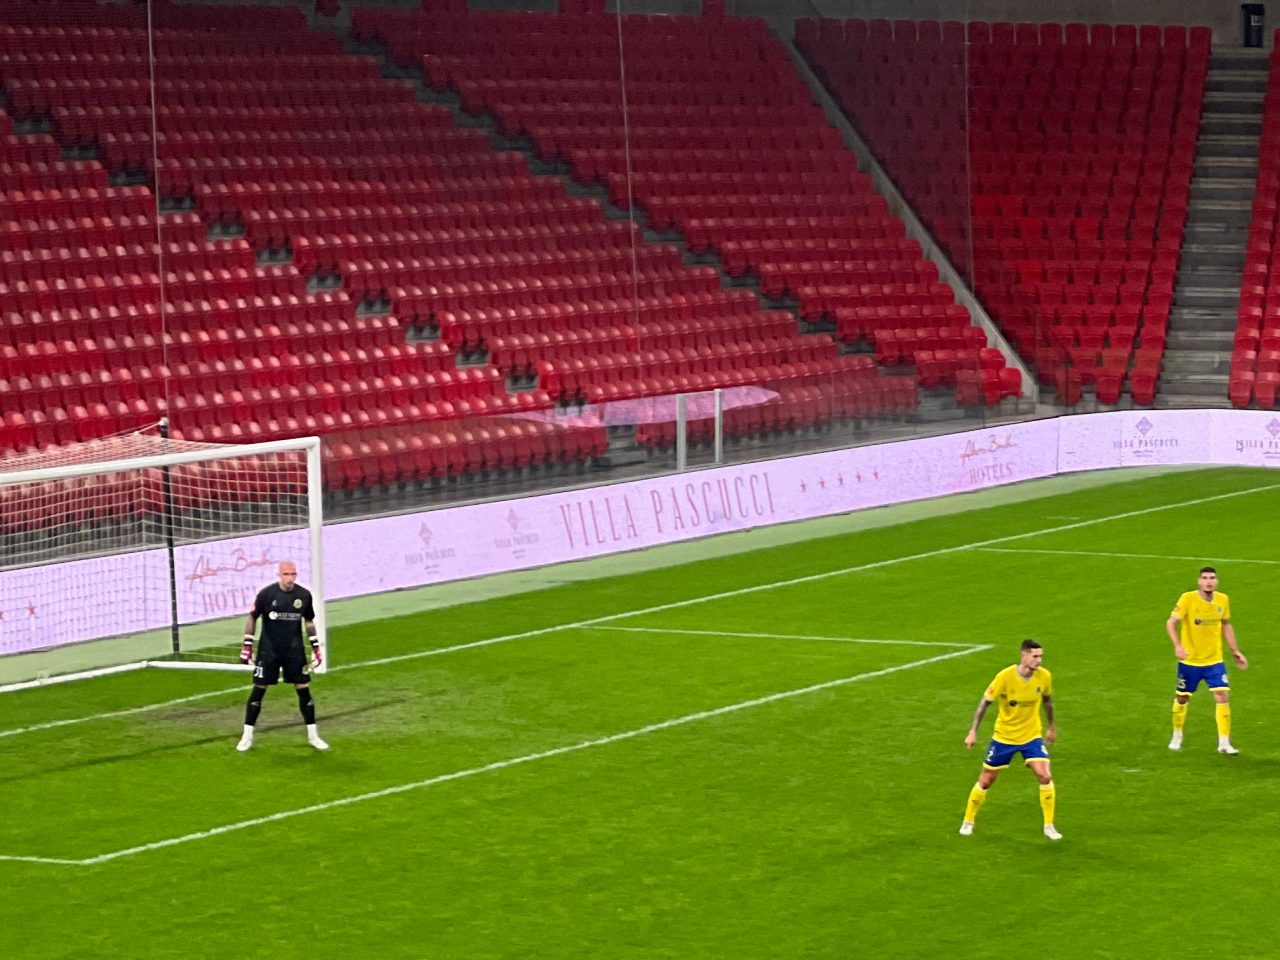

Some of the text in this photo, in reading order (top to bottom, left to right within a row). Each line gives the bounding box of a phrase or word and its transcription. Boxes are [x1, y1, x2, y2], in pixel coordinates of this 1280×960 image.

[968, 463, 1013, 484] HOTELS
[559, 472, 775, 549] VILLA PASCUCCI
